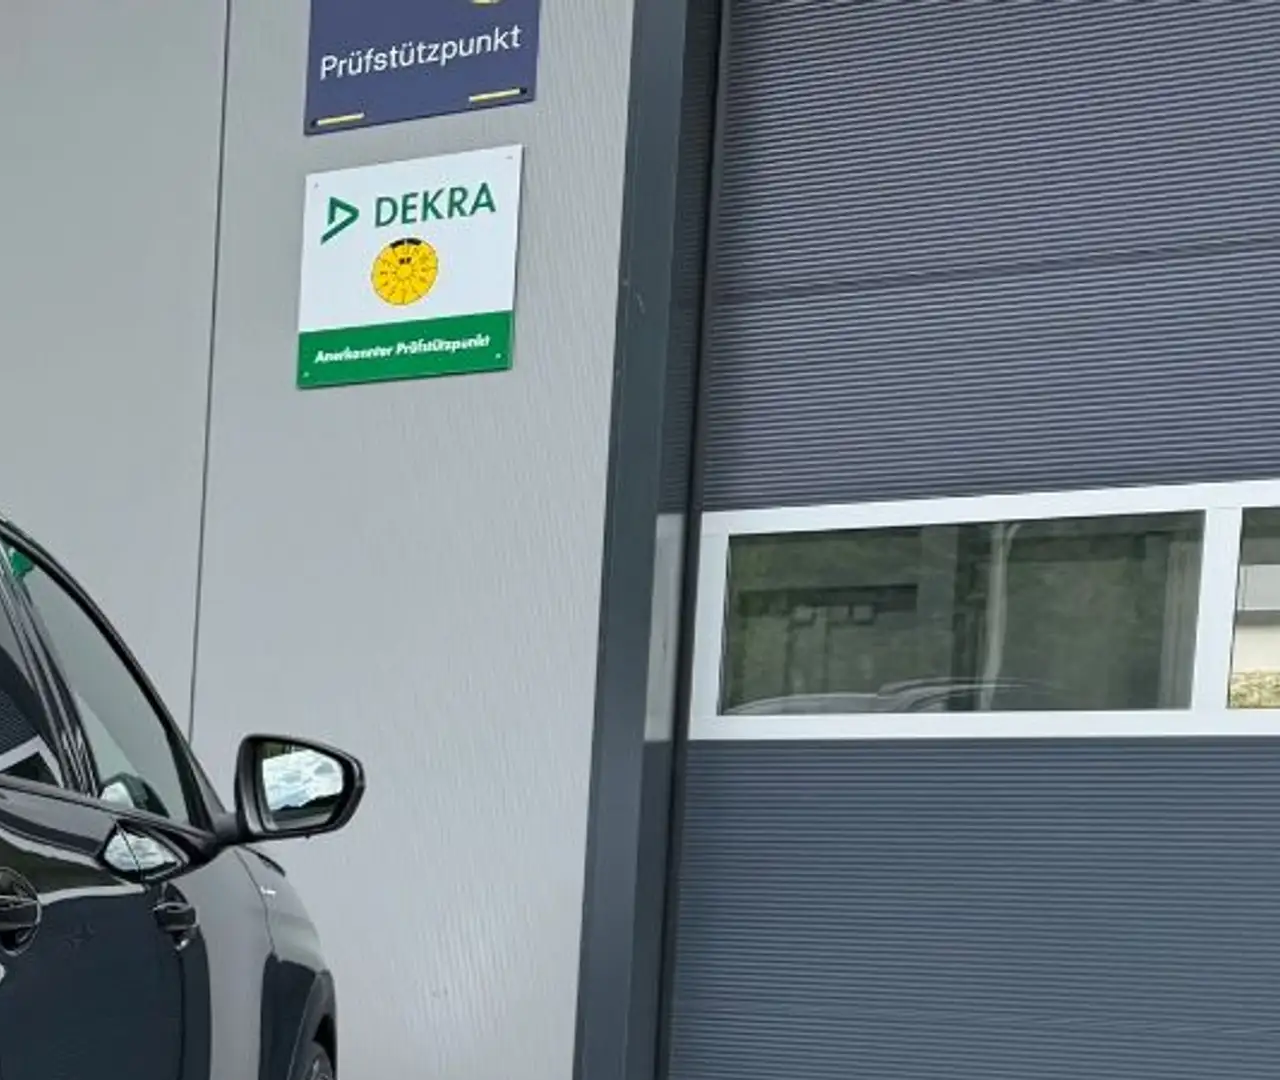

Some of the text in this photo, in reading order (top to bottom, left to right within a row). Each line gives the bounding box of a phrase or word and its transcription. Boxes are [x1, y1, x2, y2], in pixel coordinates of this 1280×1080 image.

[319, 25, 522, 81] Prüfstützpunkt
[373, 182, 497, 229] DEKRA
[313, 333, 492, 365] Anerkannter Prüfstützpunkt
